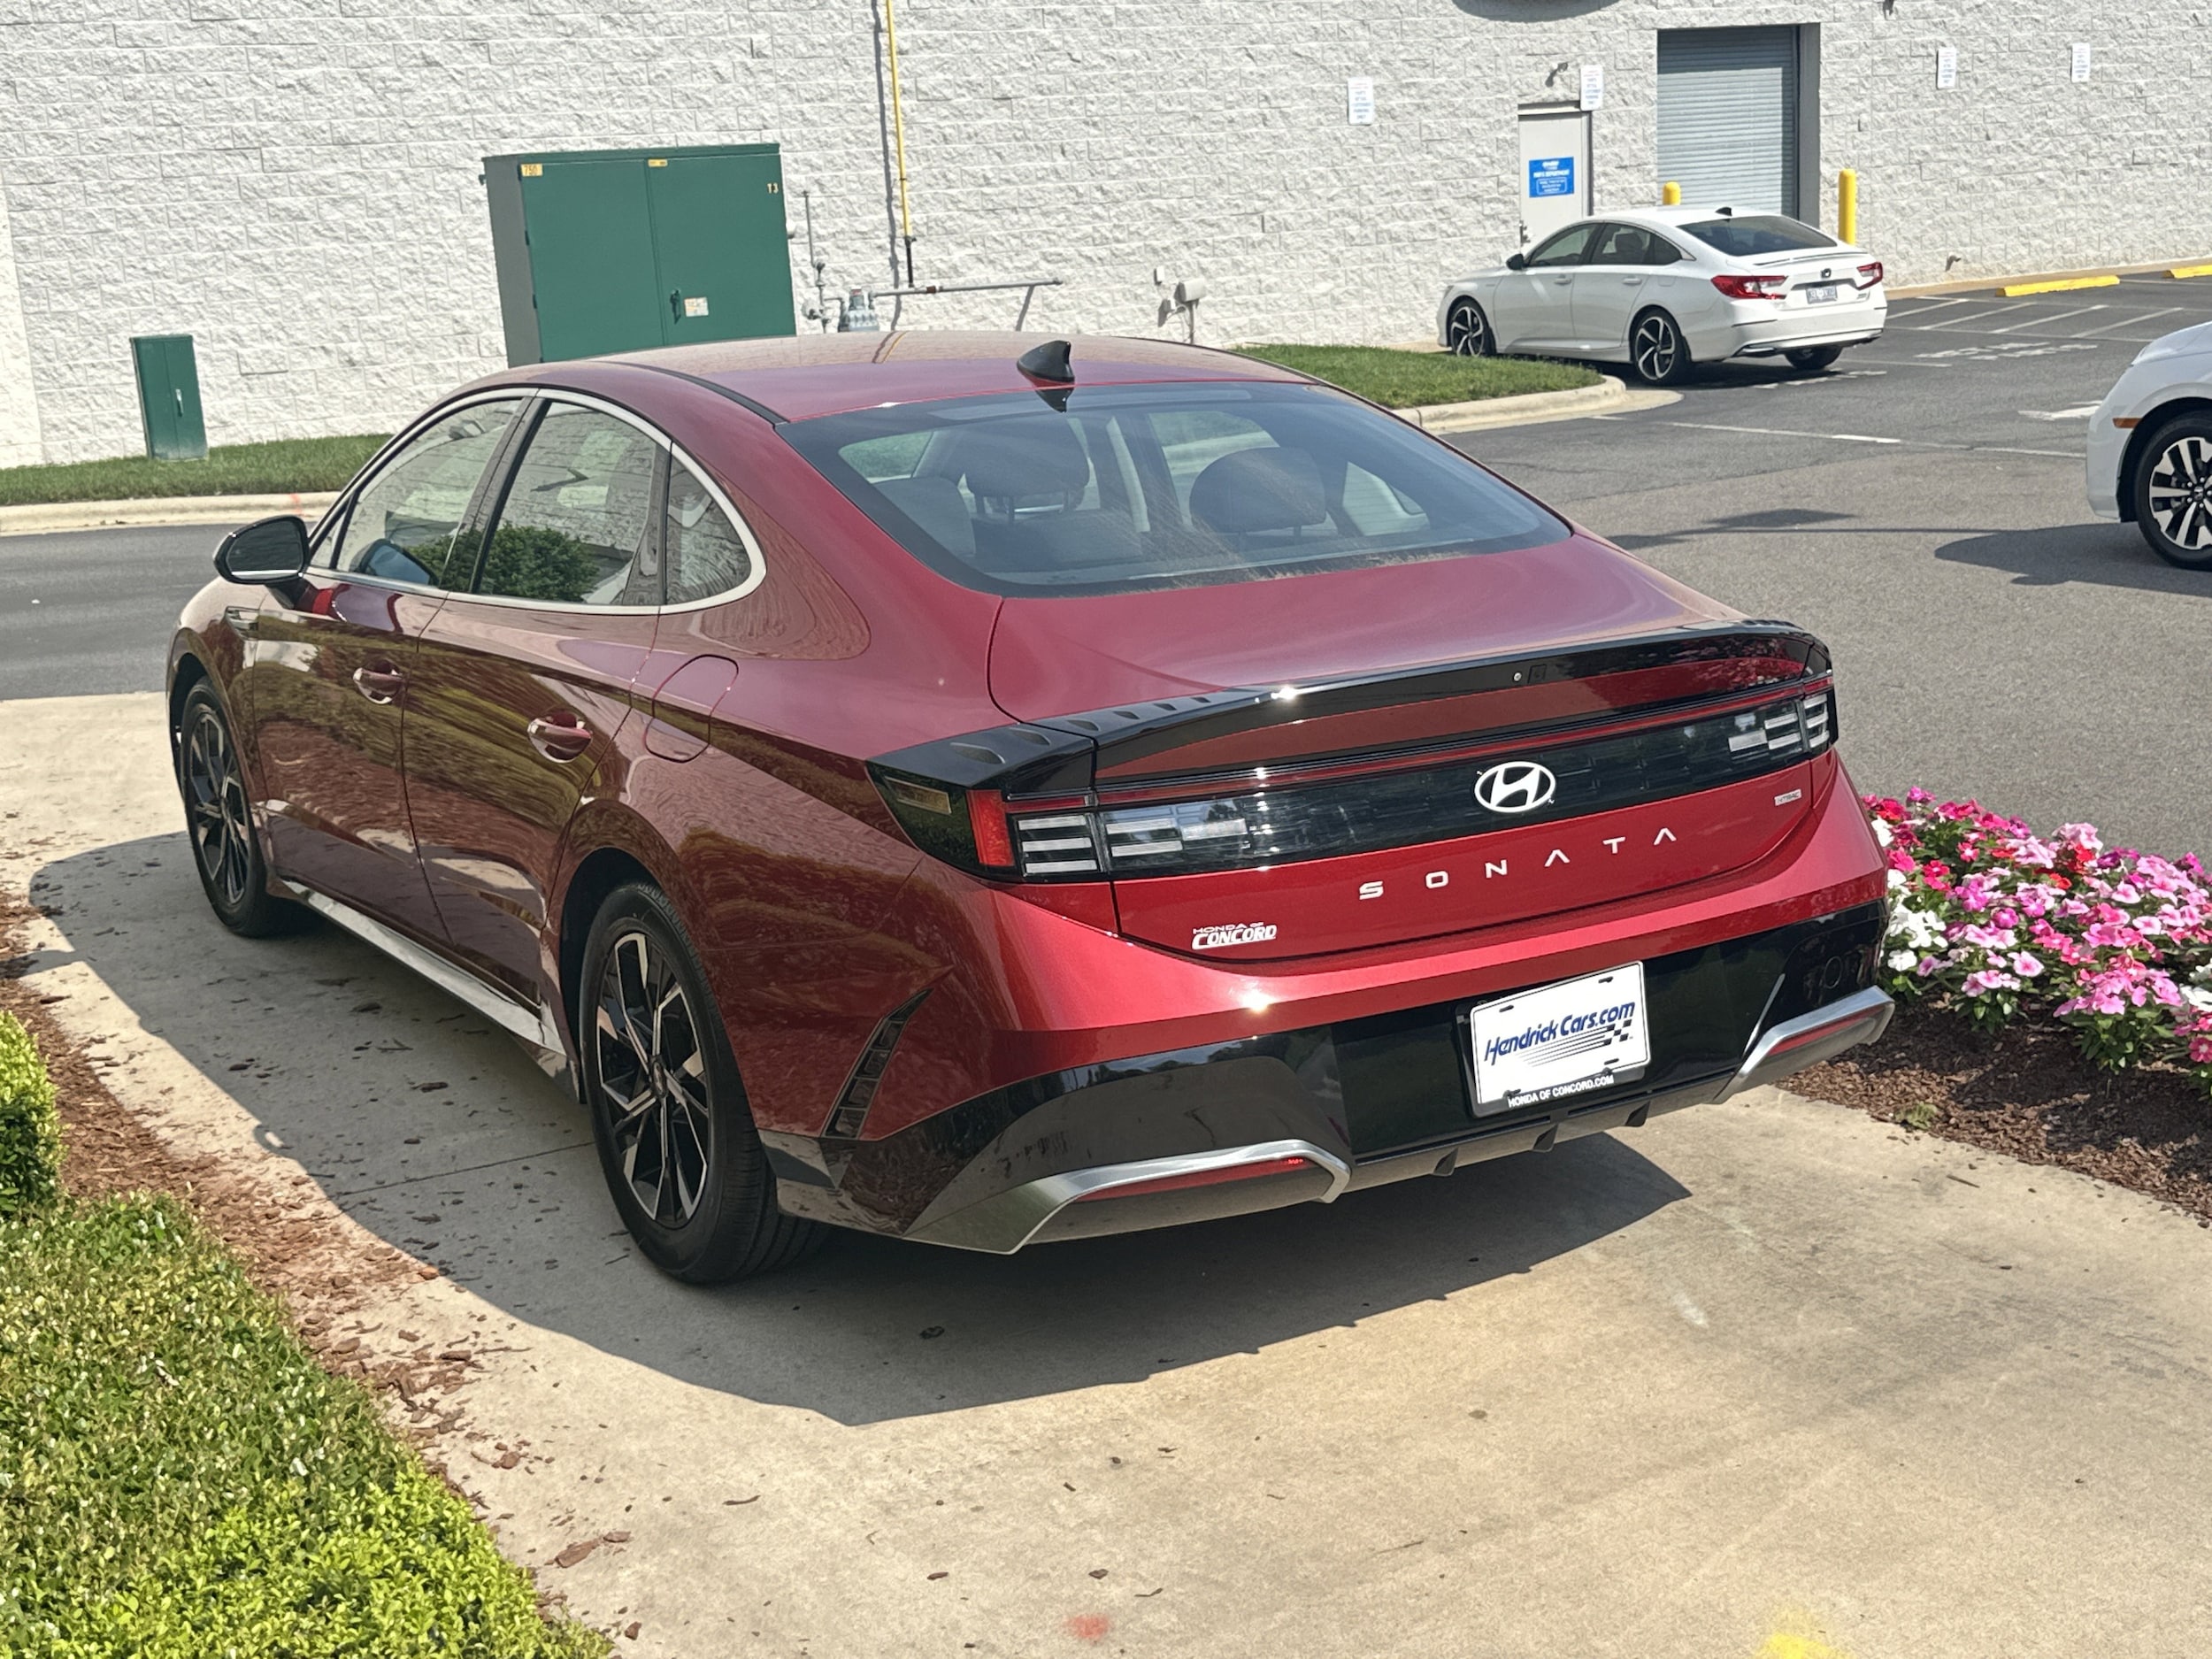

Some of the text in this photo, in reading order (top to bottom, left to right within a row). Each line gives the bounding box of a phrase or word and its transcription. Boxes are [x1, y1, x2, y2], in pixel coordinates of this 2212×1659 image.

[1359, 827, 1677, 900] SONATA
[1192, 925, 1277, 950] CONCORD
[1193, 923, 1247, 934] HONDA
[1508, 1074, 1615, 1108] HONDA OF CONCORD.COM
